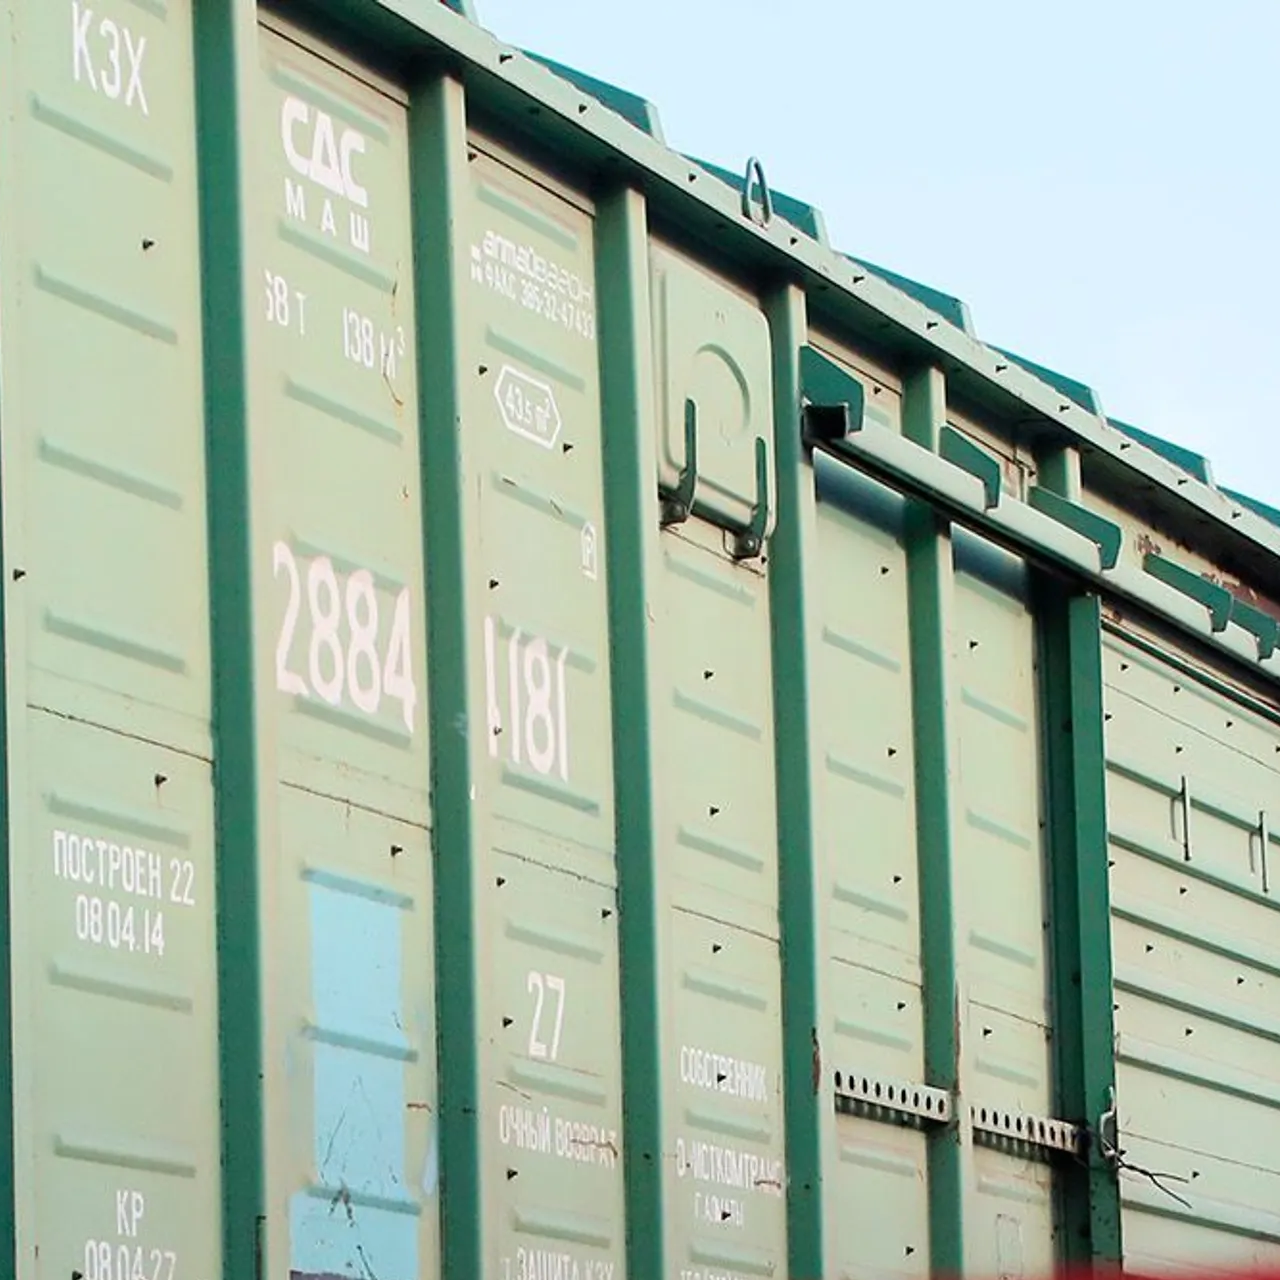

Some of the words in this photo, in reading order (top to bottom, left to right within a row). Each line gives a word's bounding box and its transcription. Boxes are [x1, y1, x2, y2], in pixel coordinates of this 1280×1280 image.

[72, 0, 150, 117] КЗХ
[343, 307, 375, 369] 138
[273, 540, 417, 734] 2884
[484, 615, 569, 783] 1181
[53, 829, 162, 899] ПОСТРОЕН
[170, 857, 196, 906] 22
[527, 971, 565, 1061] 27
[116, 1190, 144, 1237] КР
